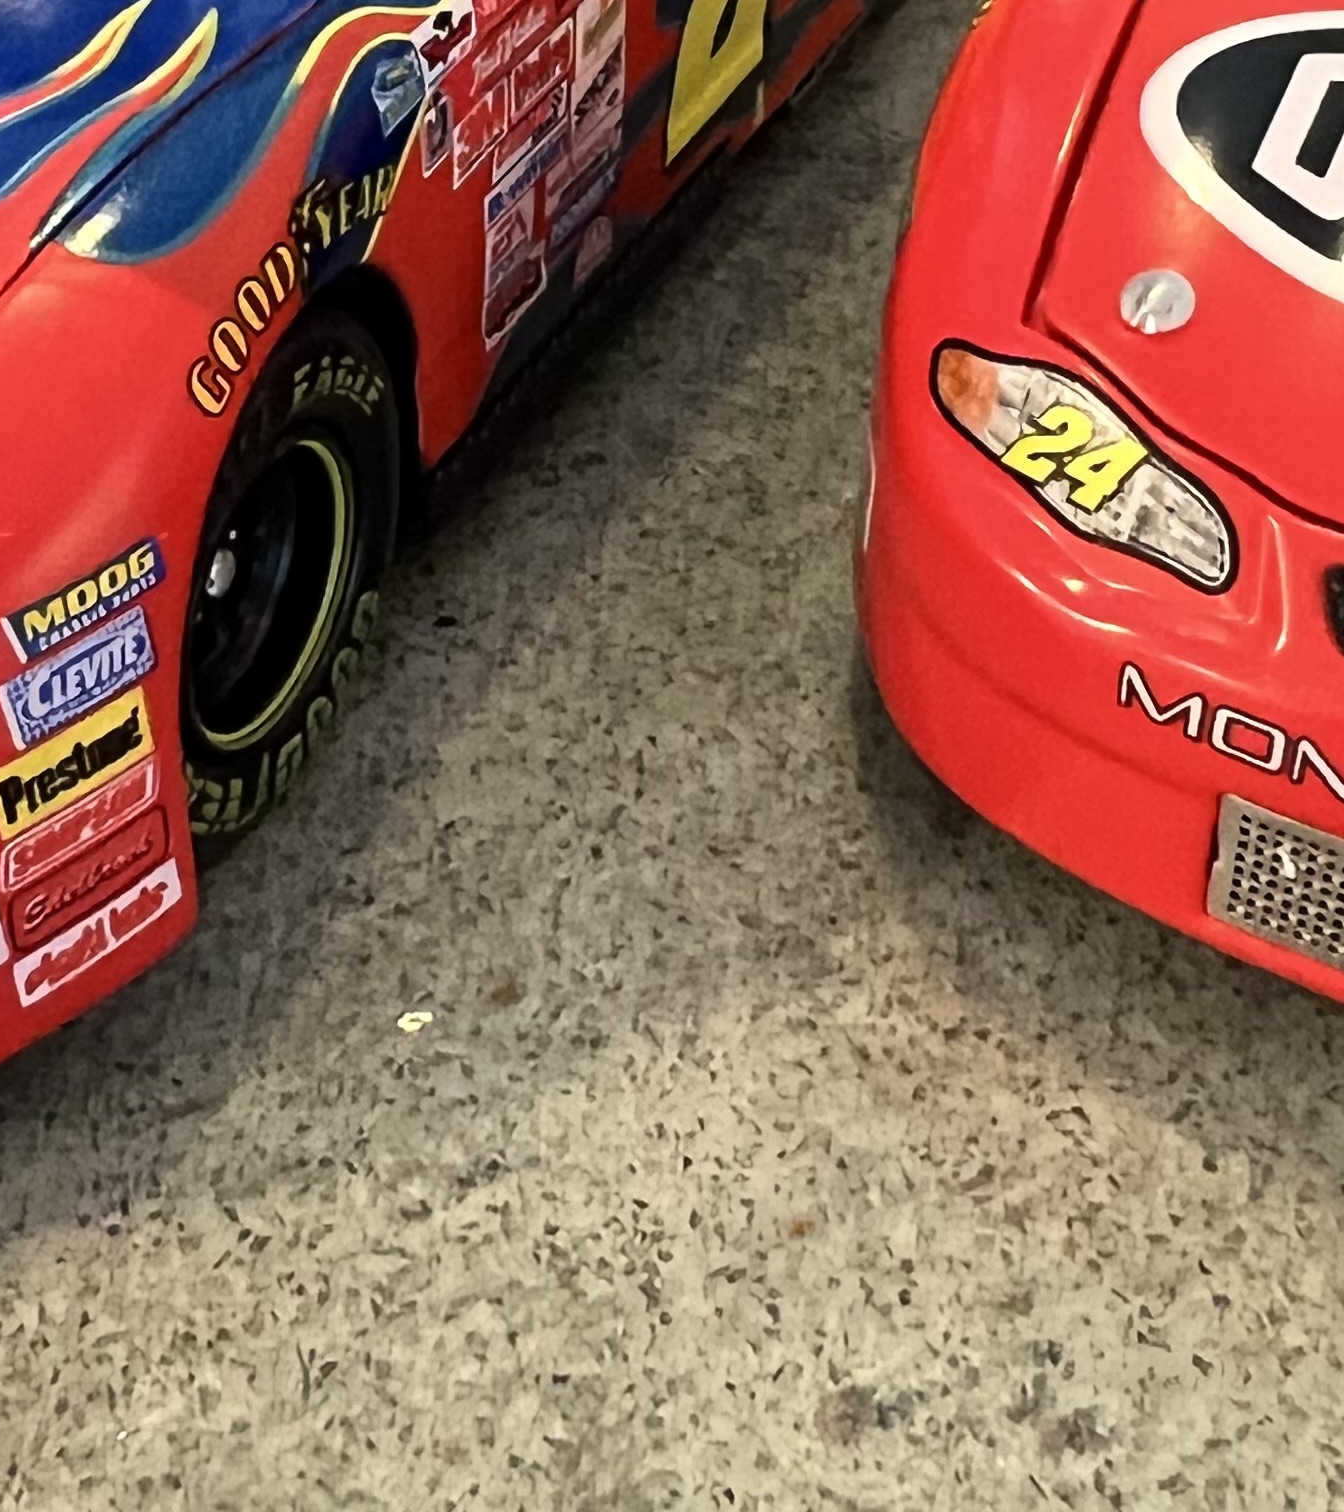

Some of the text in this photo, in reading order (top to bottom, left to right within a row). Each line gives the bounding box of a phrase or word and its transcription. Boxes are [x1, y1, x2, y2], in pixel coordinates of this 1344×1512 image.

[1002, 403, 1150, 515] 24
[22, 541, 156, 643] MOOG
[26, 624, 141, 720] CLEVITE
